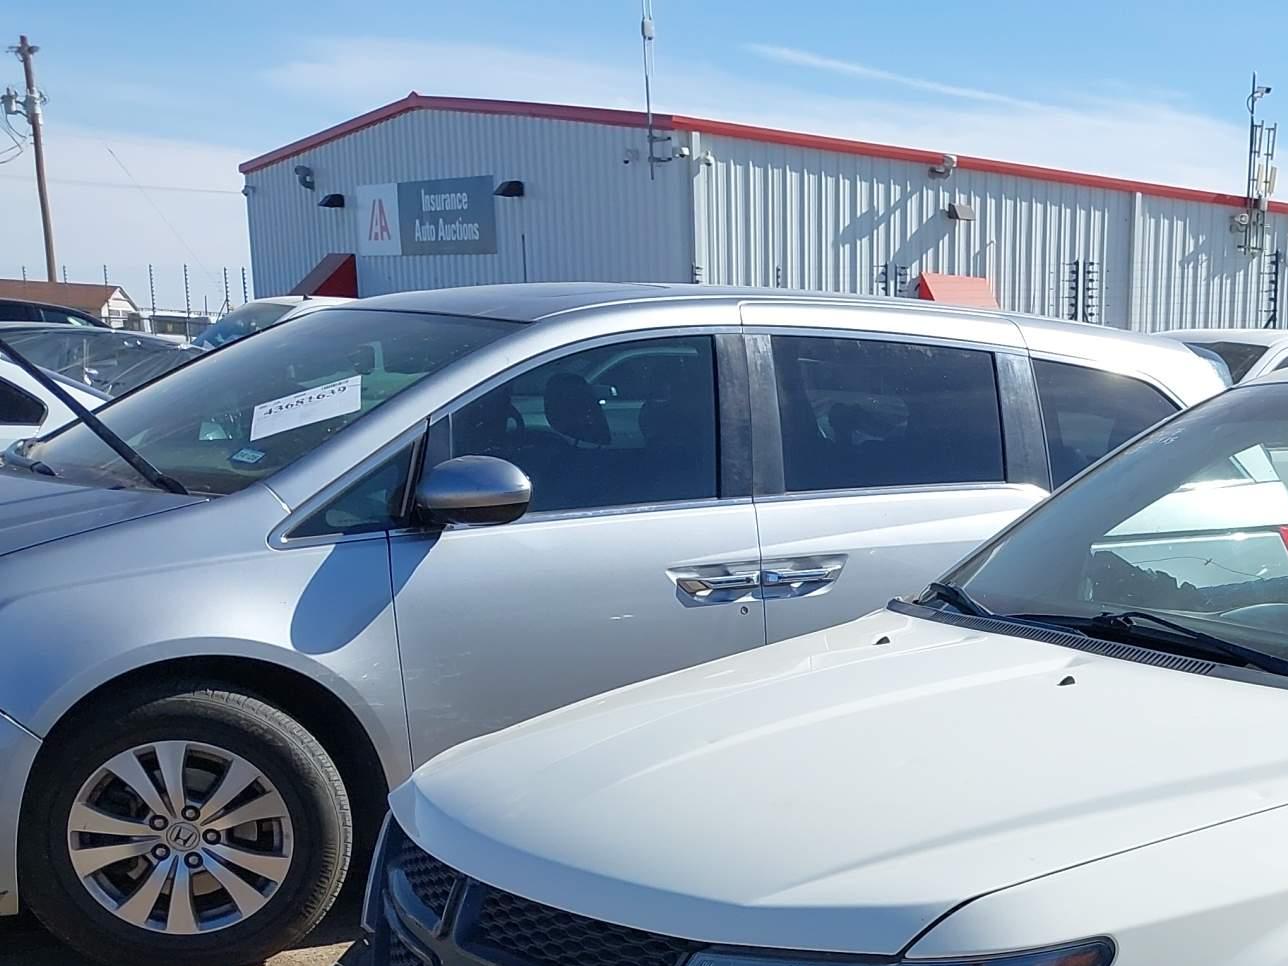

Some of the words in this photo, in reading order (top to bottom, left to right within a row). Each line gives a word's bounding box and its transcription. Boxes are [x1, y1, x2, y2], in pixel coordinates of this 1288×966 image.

[421, 188, 468, 212] Insurance
[415, 219, 436, 242] Auto
[438, 217, 480, 241] Auctions
